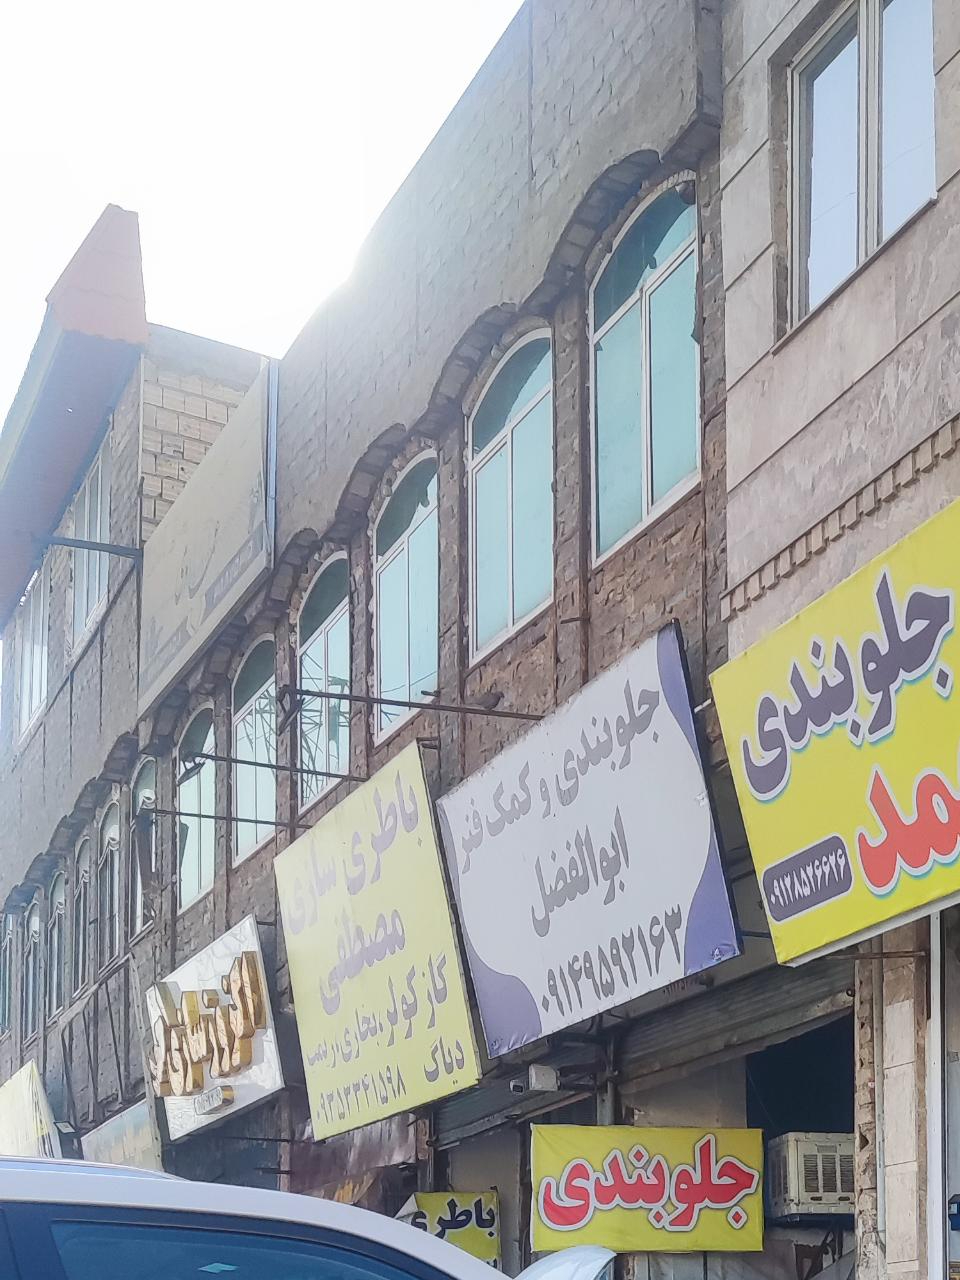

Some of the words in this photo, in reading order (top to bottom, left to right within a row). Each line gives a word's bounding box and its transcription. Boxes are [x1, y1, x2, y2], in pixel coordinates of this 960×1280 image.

[744, 571, 951, 795] جلوبندی
[539, 777, 551, 819] و
[555, 679, 660, 807] جلوبندی
[342, 769, 423, 896] باطری
[531, 803, 630, 938] ابوالفضل
[770, 848, 846, 907] ۰۹۱۲۸۵۲۶۶۲۶
[319, 903, 406, 1016] مصطفی
[541, 903, 682, 1017] ۰۹۱۴۹۵۹۲۱۶۳
[540, 1136, 758, 1229] جلوبندی
